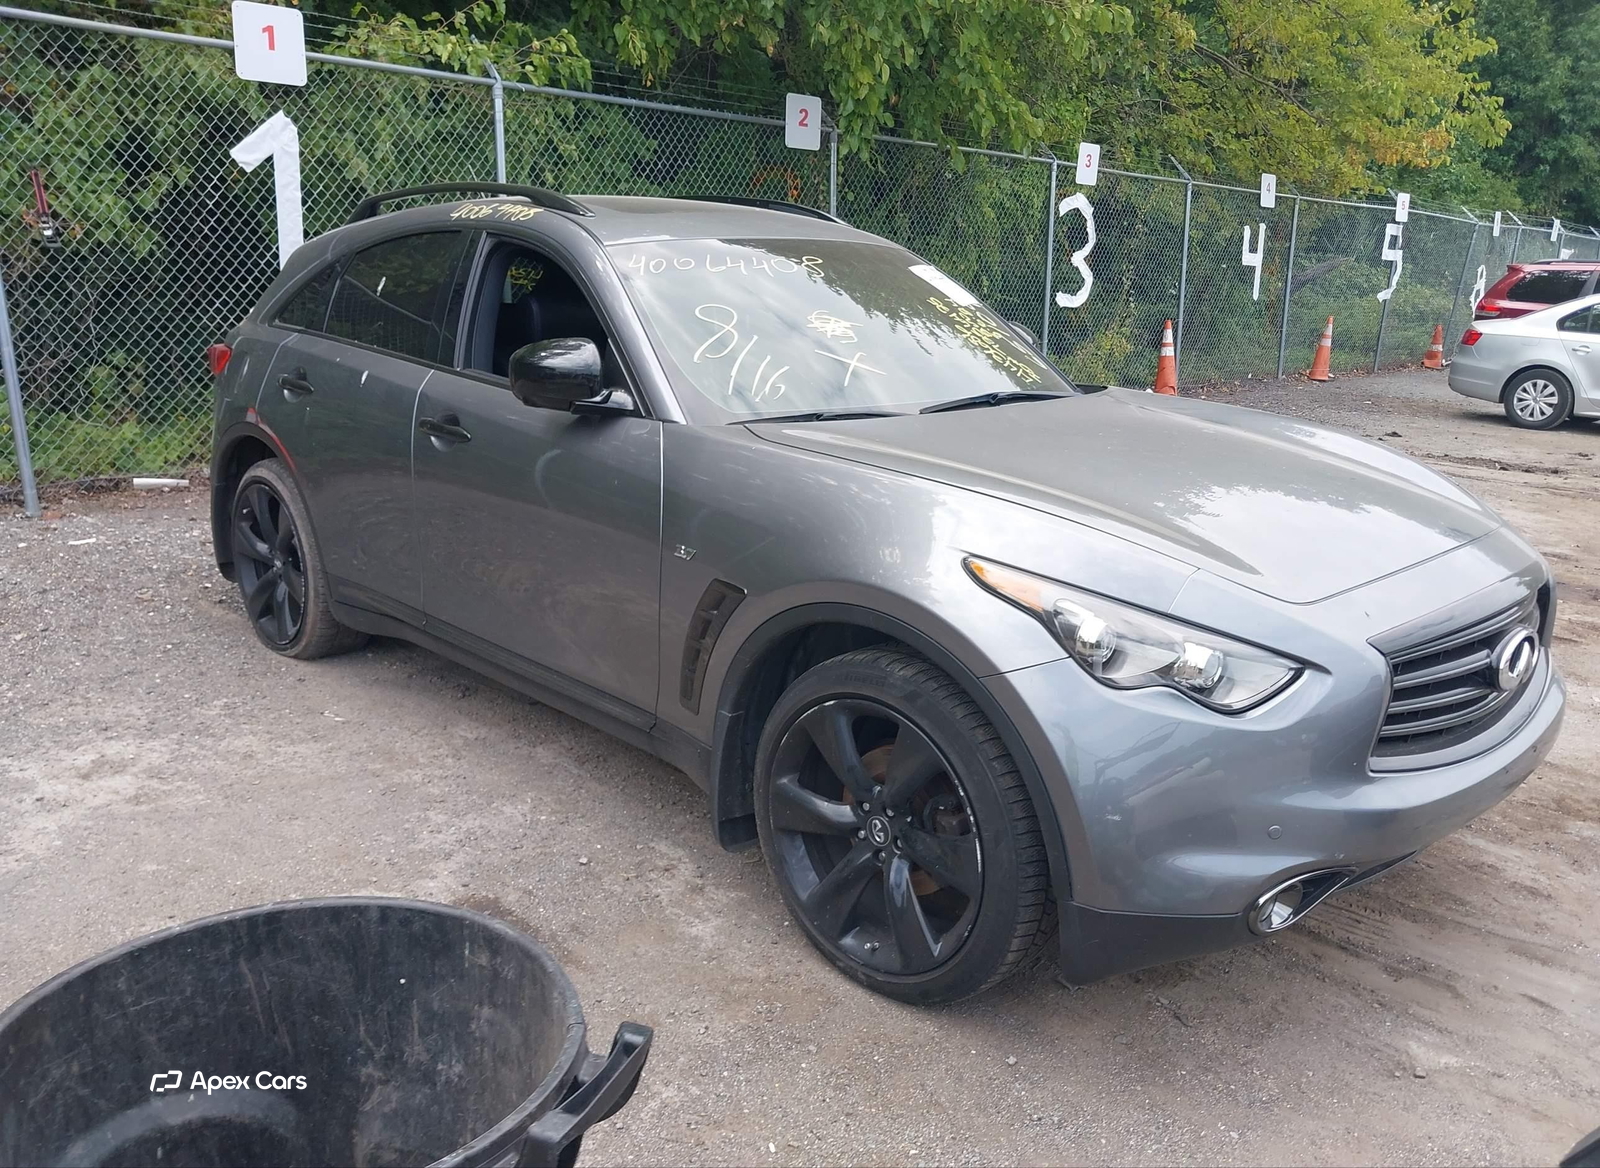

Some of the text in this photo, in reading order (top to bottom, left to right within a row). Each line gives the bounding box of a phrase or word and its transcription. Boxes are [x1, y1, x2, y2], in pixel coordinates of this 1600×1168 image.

[261, 24, 276, 51] 1
[798, 108, 809, 128] 2
[1085, 153, 1092, 168] 3
[229, 110, 304, 271] 1
[1265, 182, 1271, 194] 4
[1055, 192, 1096, 308] 3
[1242, 223, 1266, 300] 4
[1377, 223, 1403, 303] 5
